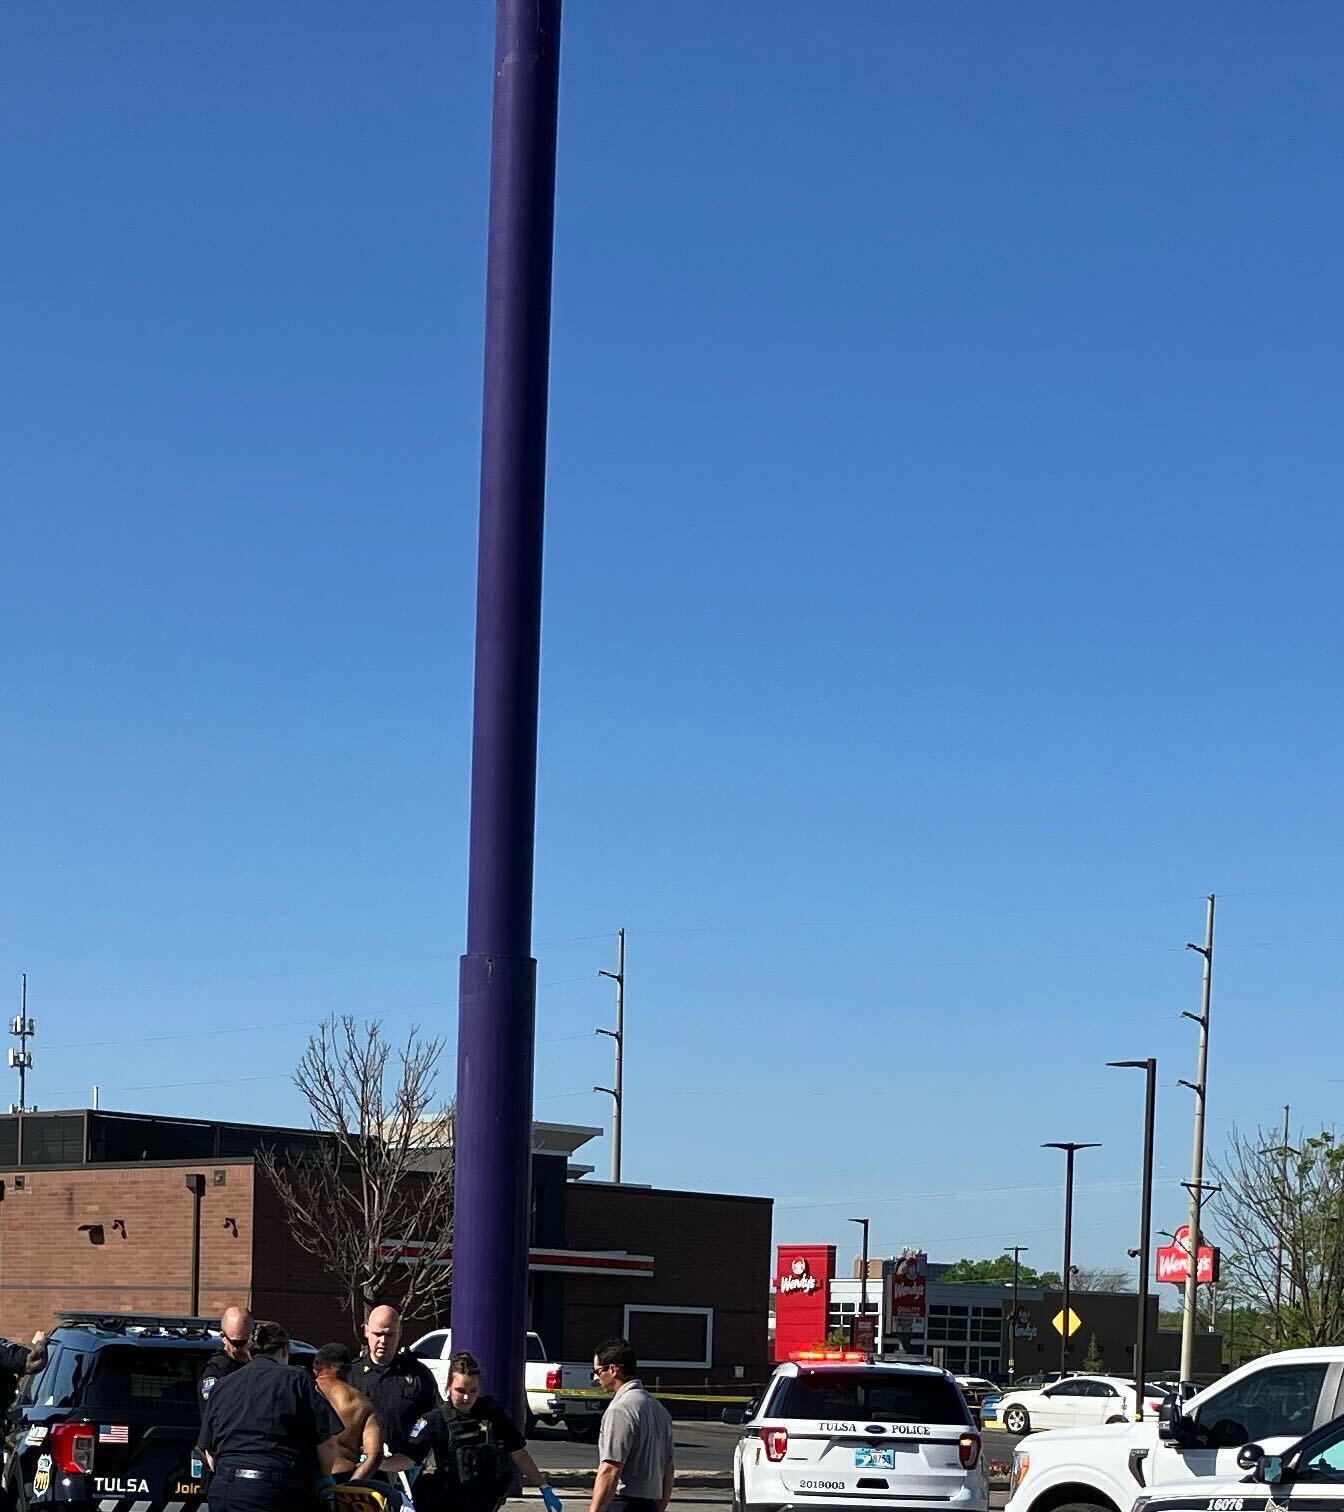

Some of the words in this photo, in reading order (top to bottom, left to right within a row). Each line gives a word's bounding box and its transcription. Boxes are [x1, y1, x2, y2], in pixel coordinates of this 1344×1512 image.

[781, 1274, 816, 1293] Wendy's
[894, 1281, 924, 1300] Wendy's
[818, 1422, 857, 1432] TULSA
[891, 1425, 931, 1436] POLICE
[94, 1477, 150, 1493] TULSA
[1206, 1499, 1244, 1511] 16076
